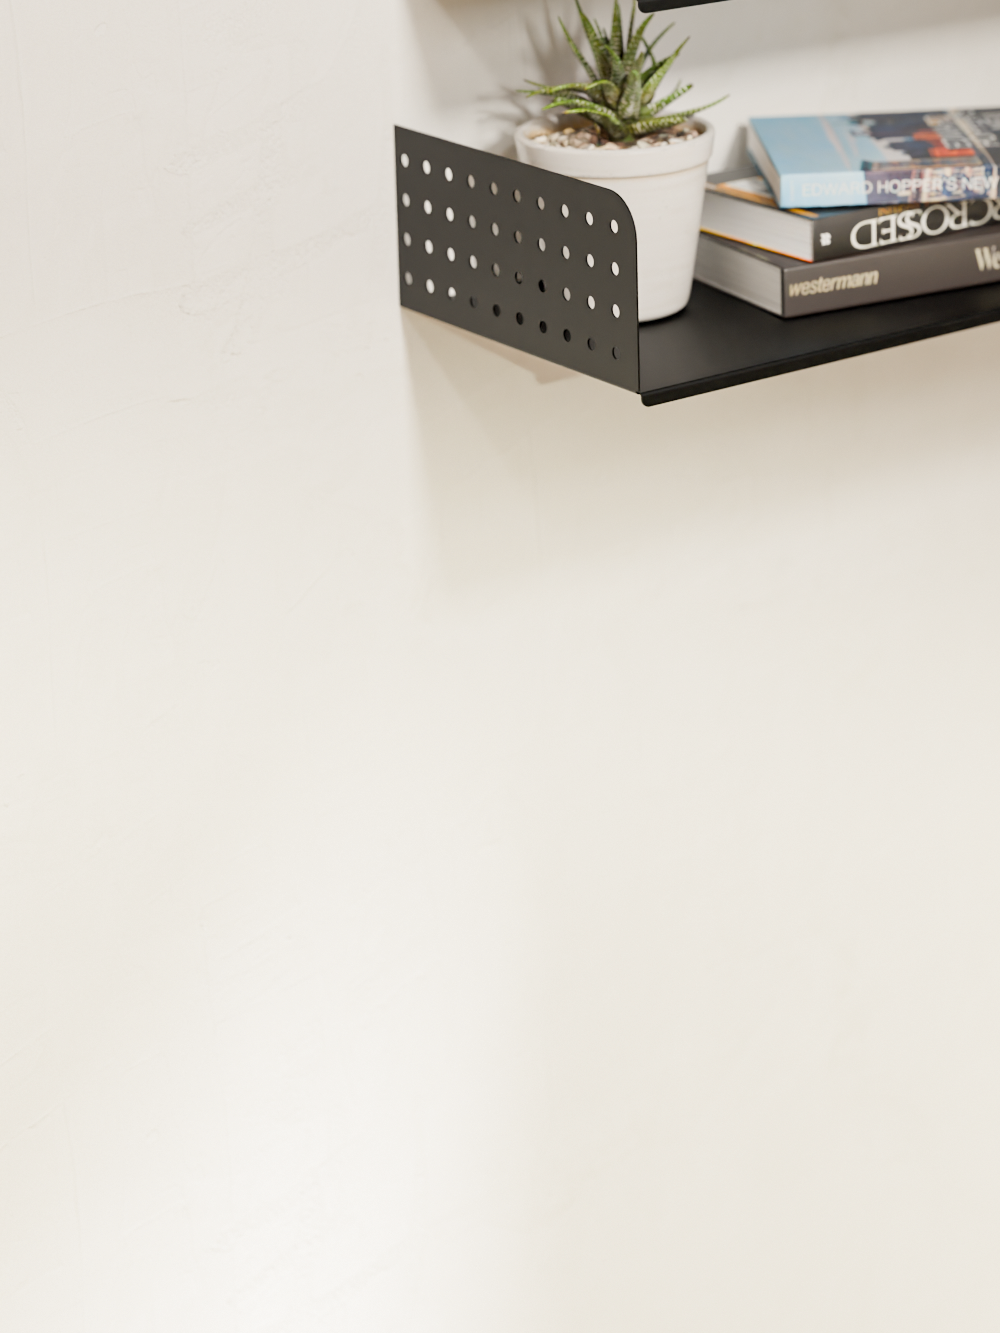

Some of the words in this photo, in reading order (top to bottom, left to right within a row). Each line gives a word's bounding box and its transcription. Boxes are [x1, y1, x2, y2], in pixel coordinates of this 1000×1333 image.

[801, 179, 874, 198] EDWARD
[876, 174, 957, 195] HOPPER'S
[961, 174, 1000, 192] NEW
[788, 270, 880, 298] westermann
